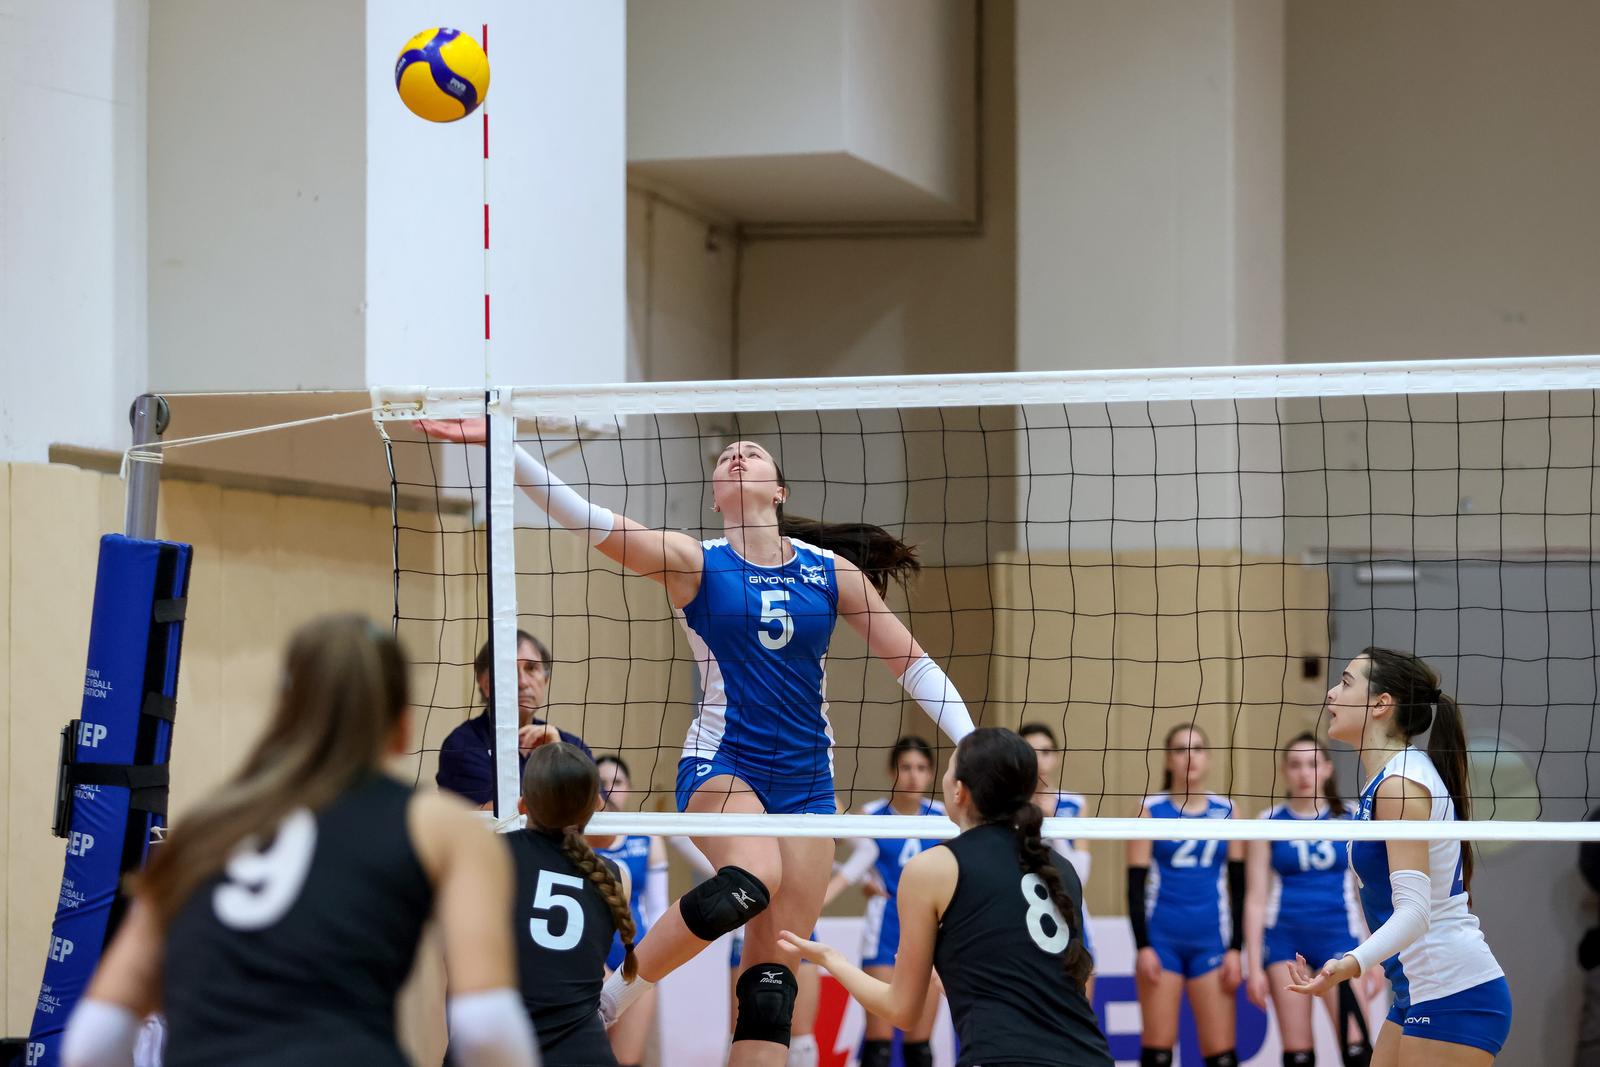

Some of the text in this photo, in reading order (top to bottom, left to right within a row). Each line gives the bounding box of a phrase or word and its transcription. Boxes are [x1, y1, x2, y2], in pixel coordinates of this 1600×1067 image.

[748, 575, 796, 585] GIVOVA
[757, 589, 794, 651] 5
[211, 808, 318, 932] 9
[1288, 840, 1337, 872] 13
[529, 869, 585, 951] 5
[1020, 872, 1070, 954] 8
[1404, 1016, 1431, 1025] OVA
